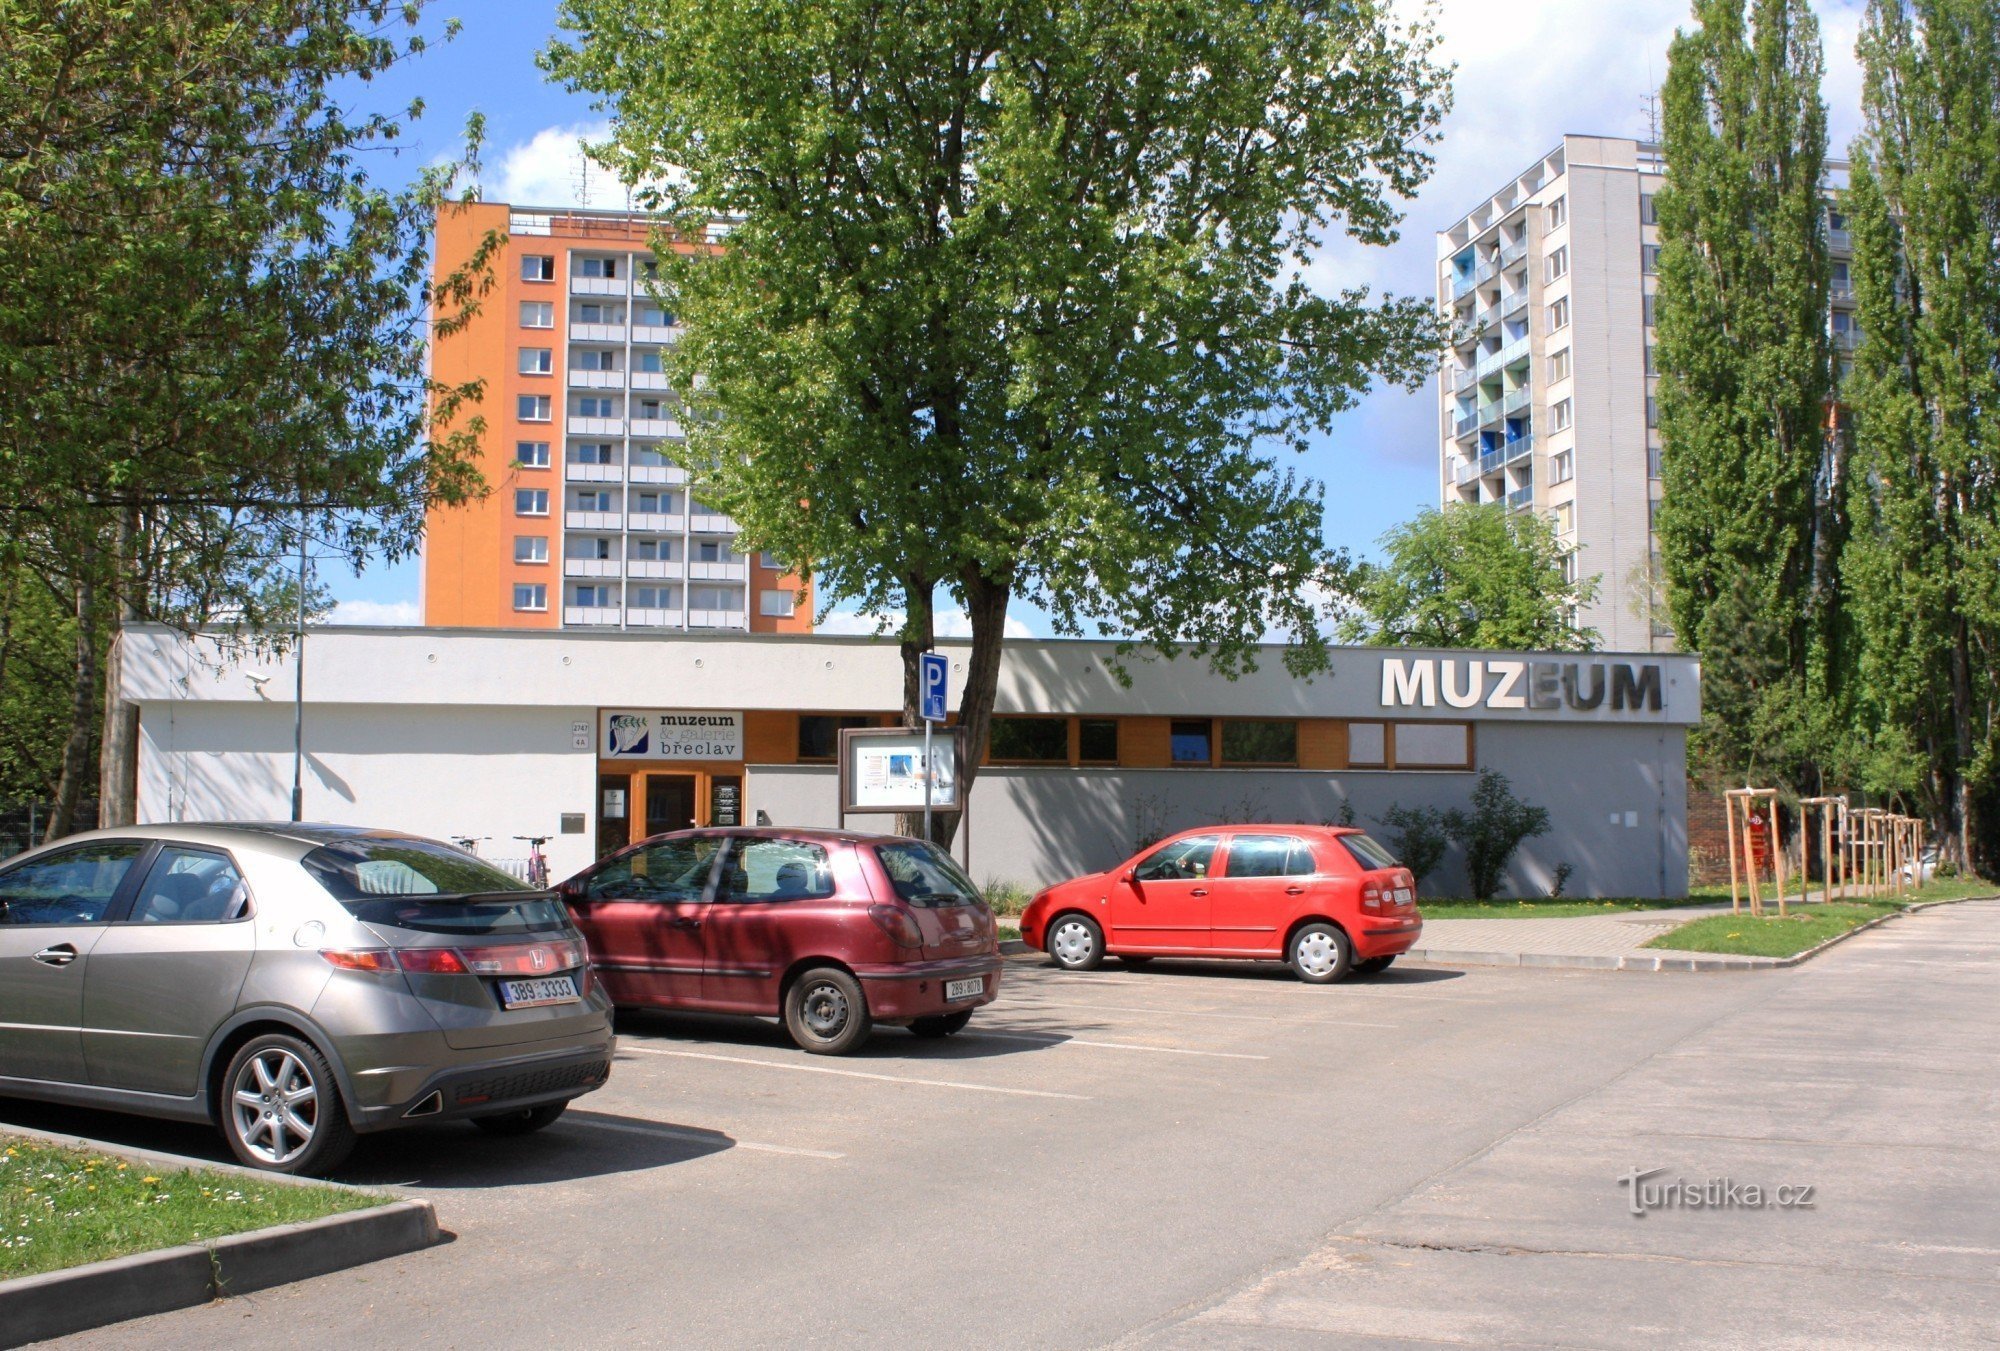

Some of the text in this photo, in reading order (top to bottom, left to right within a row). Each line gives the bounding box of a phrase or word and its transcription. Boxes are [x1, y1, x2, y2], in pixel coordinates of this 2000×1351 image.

[927, 663, 942, 698] P
[1381, 658, 1662, 711] MUZEUM
[660, 715, 734, 726] muzeum
[660, 727, 735, 743] & galerie
[661, 742, 735, 755] břeclav
